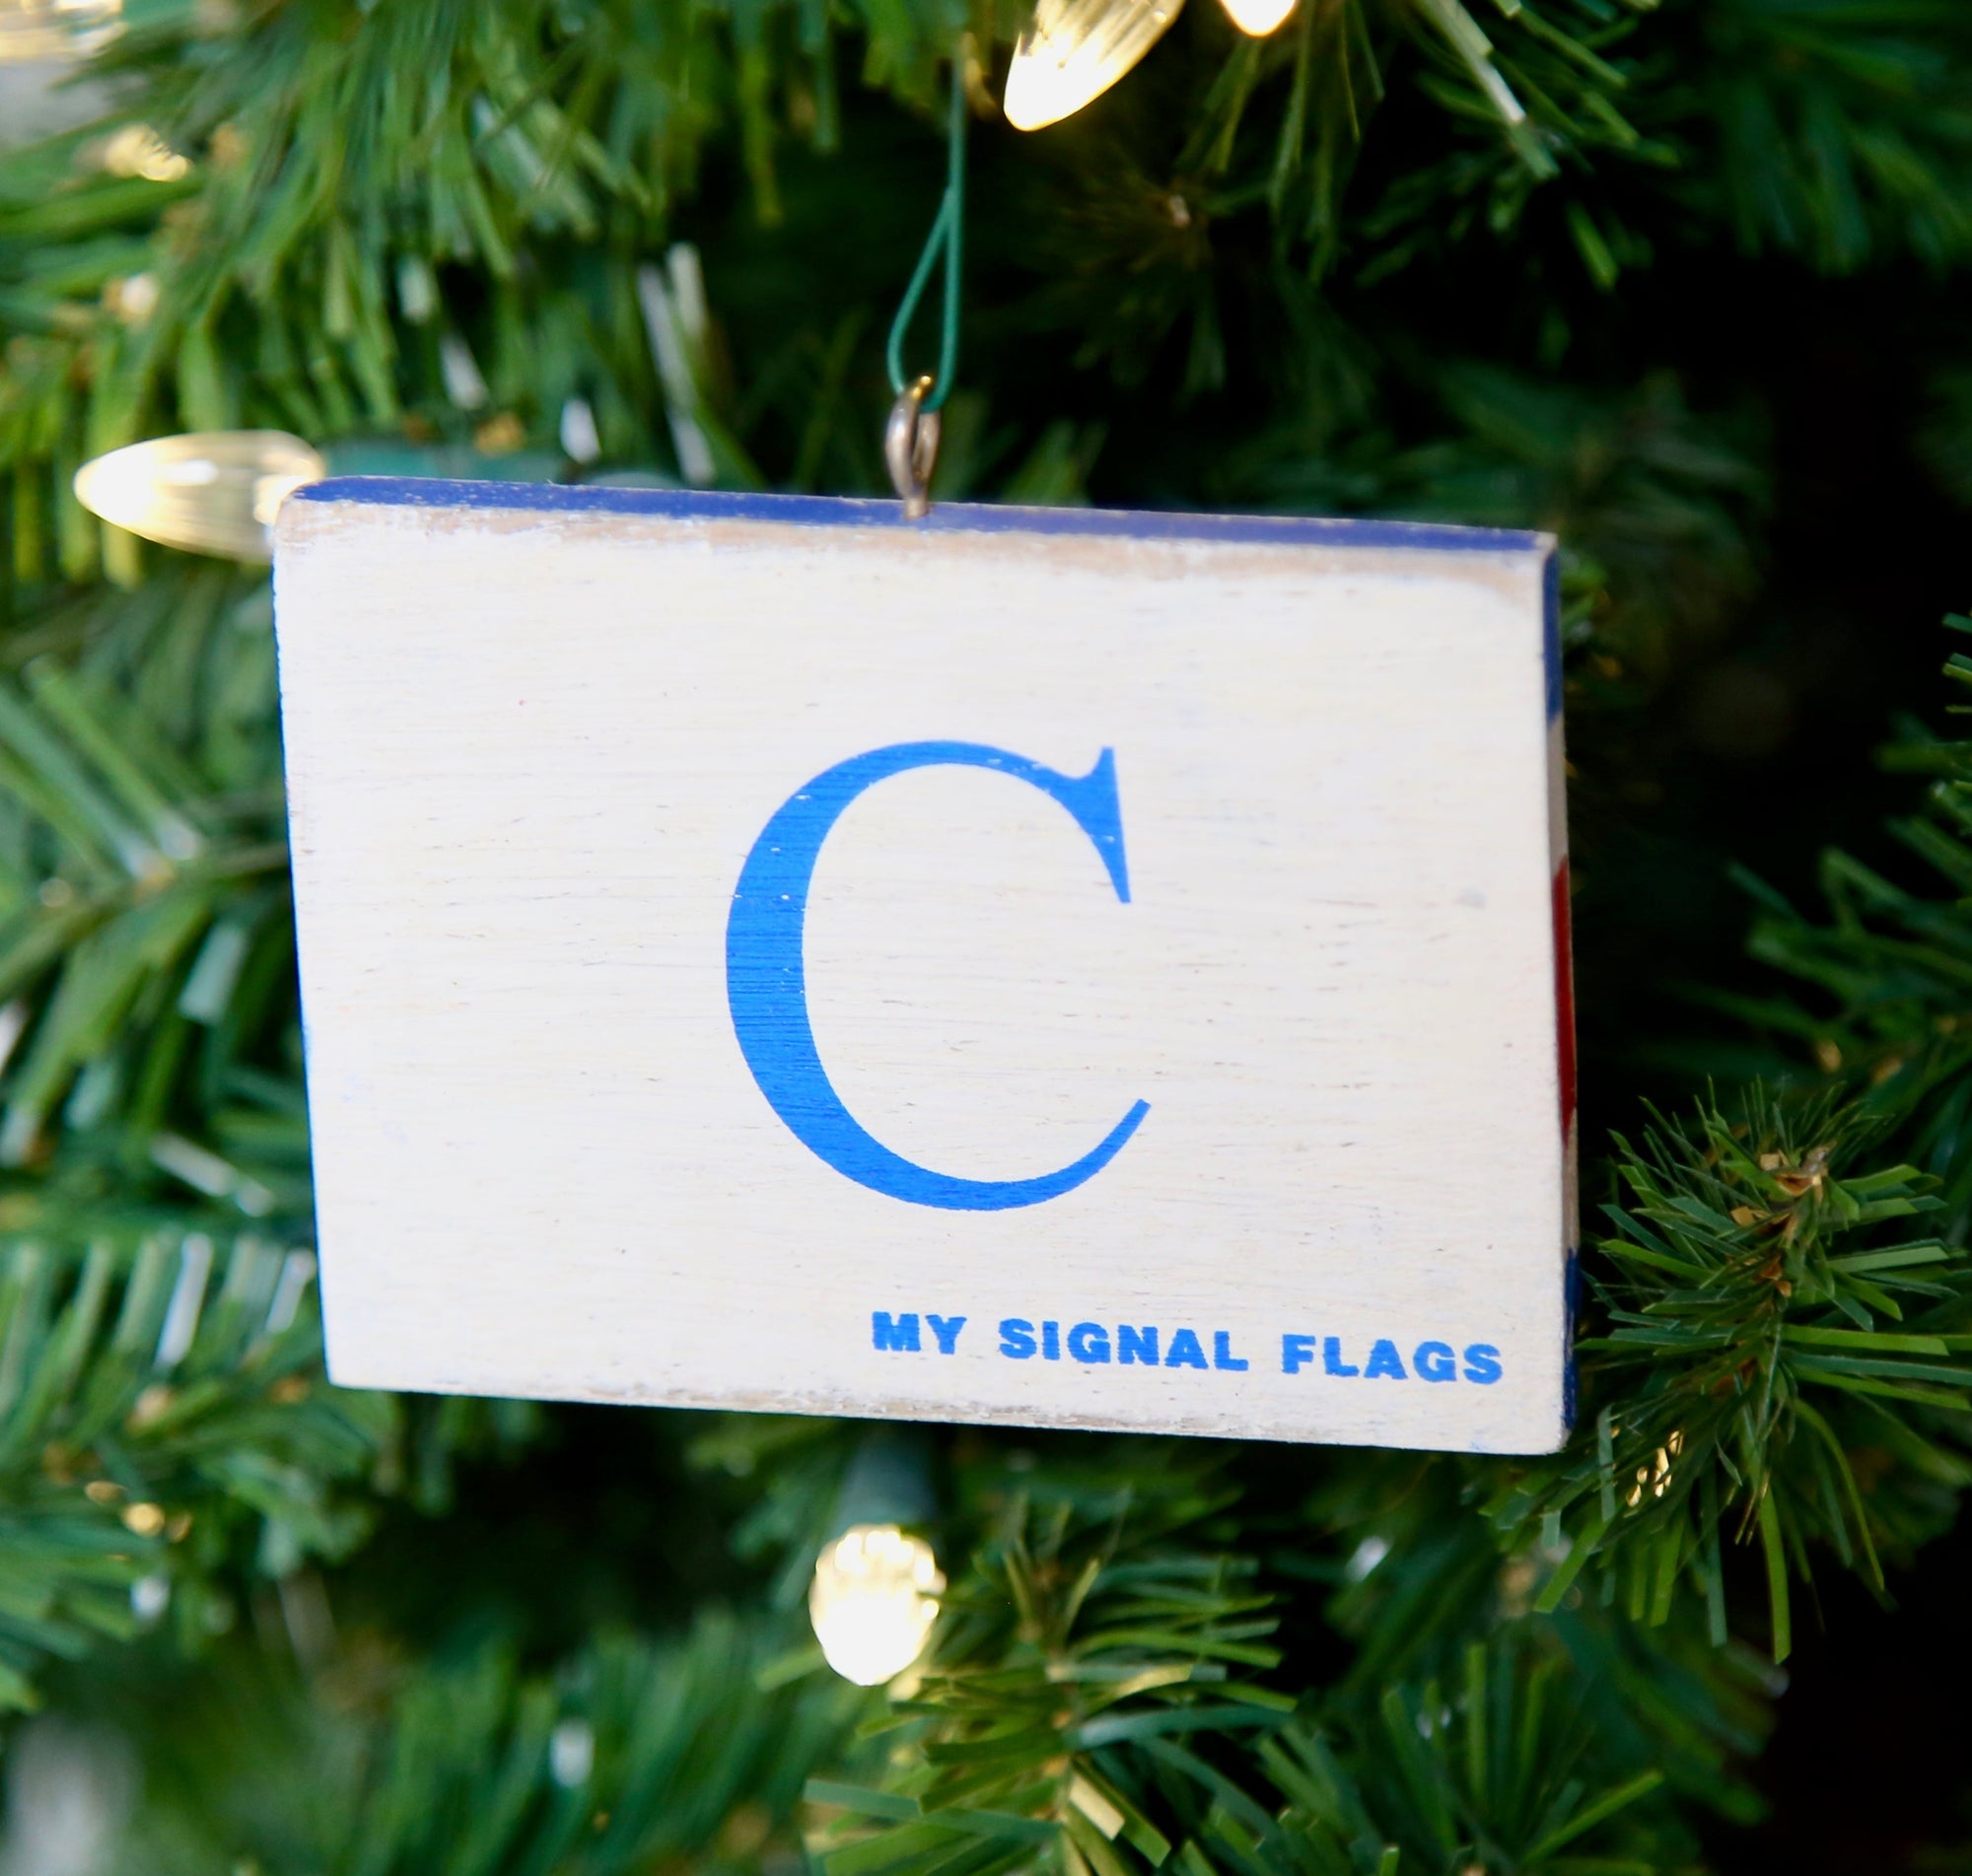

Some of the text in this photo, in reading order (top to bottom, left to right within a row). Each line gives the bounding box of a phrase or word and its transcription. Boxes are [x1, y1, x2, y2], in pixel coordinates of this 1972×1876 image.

[727, 740, 1150, 1211] C
[872, 1311, 1503, 1385] MY SIGNAL FLAGS
